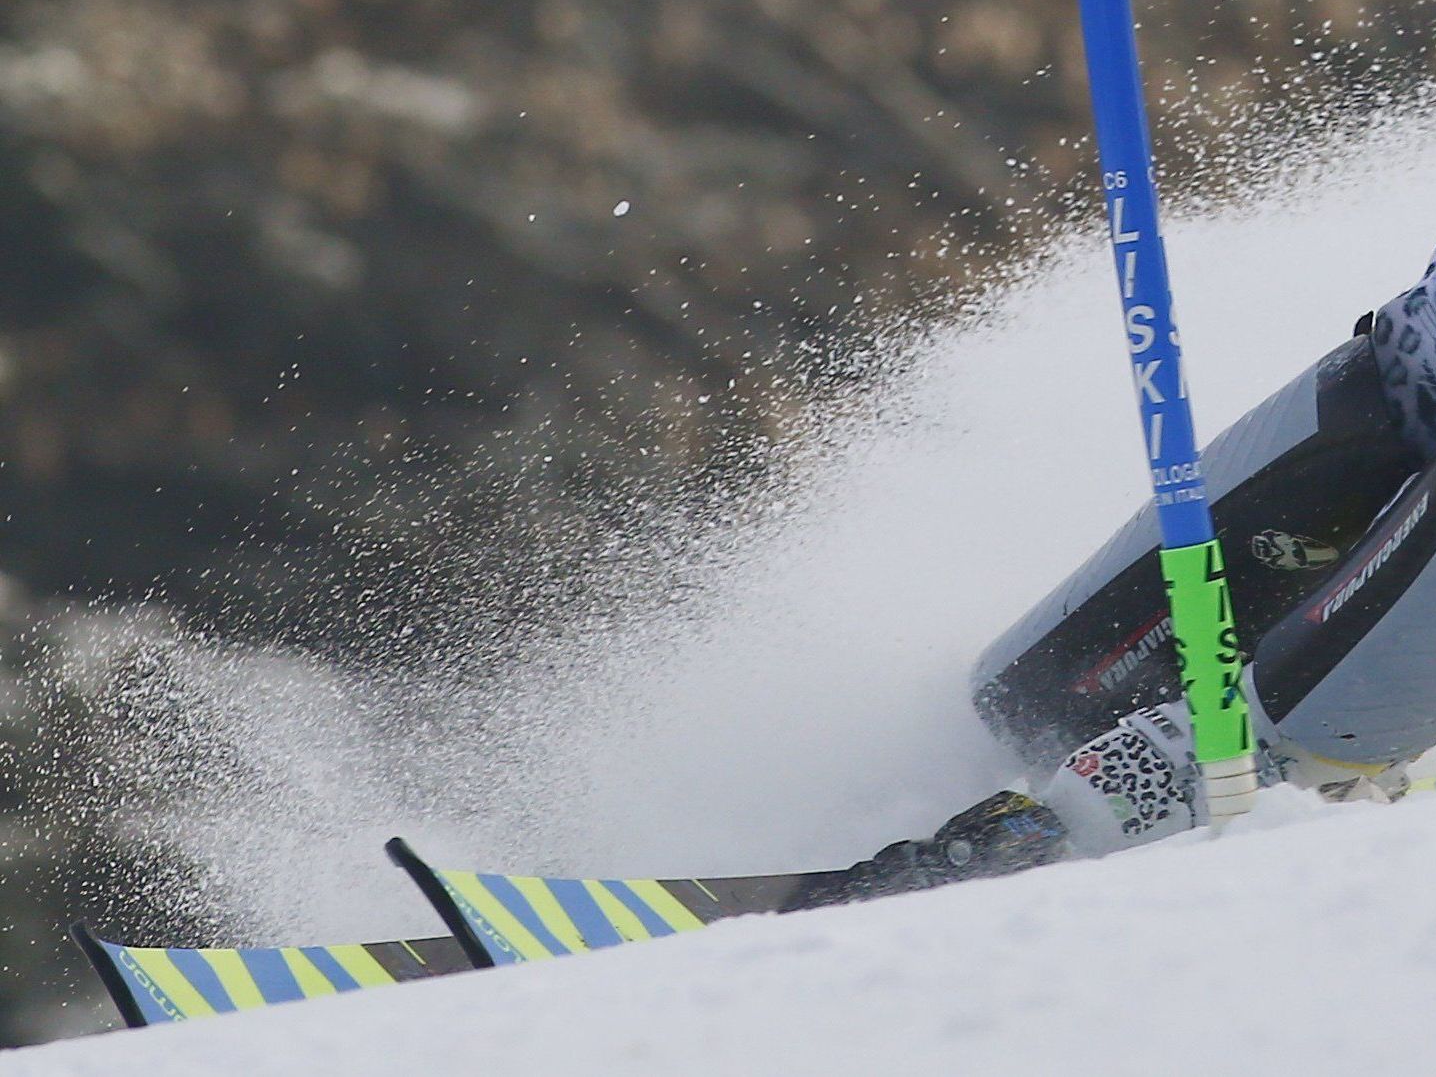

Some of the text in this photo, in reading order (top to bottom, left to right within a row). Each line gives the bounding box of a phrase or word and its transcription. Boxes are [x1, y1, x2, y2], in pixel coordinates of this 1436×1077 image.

[1102, 170, 1128, 190] C6
[1112, 196, 1166, 461] LISKI
[1205, 544, 1249, 751] LISKI
